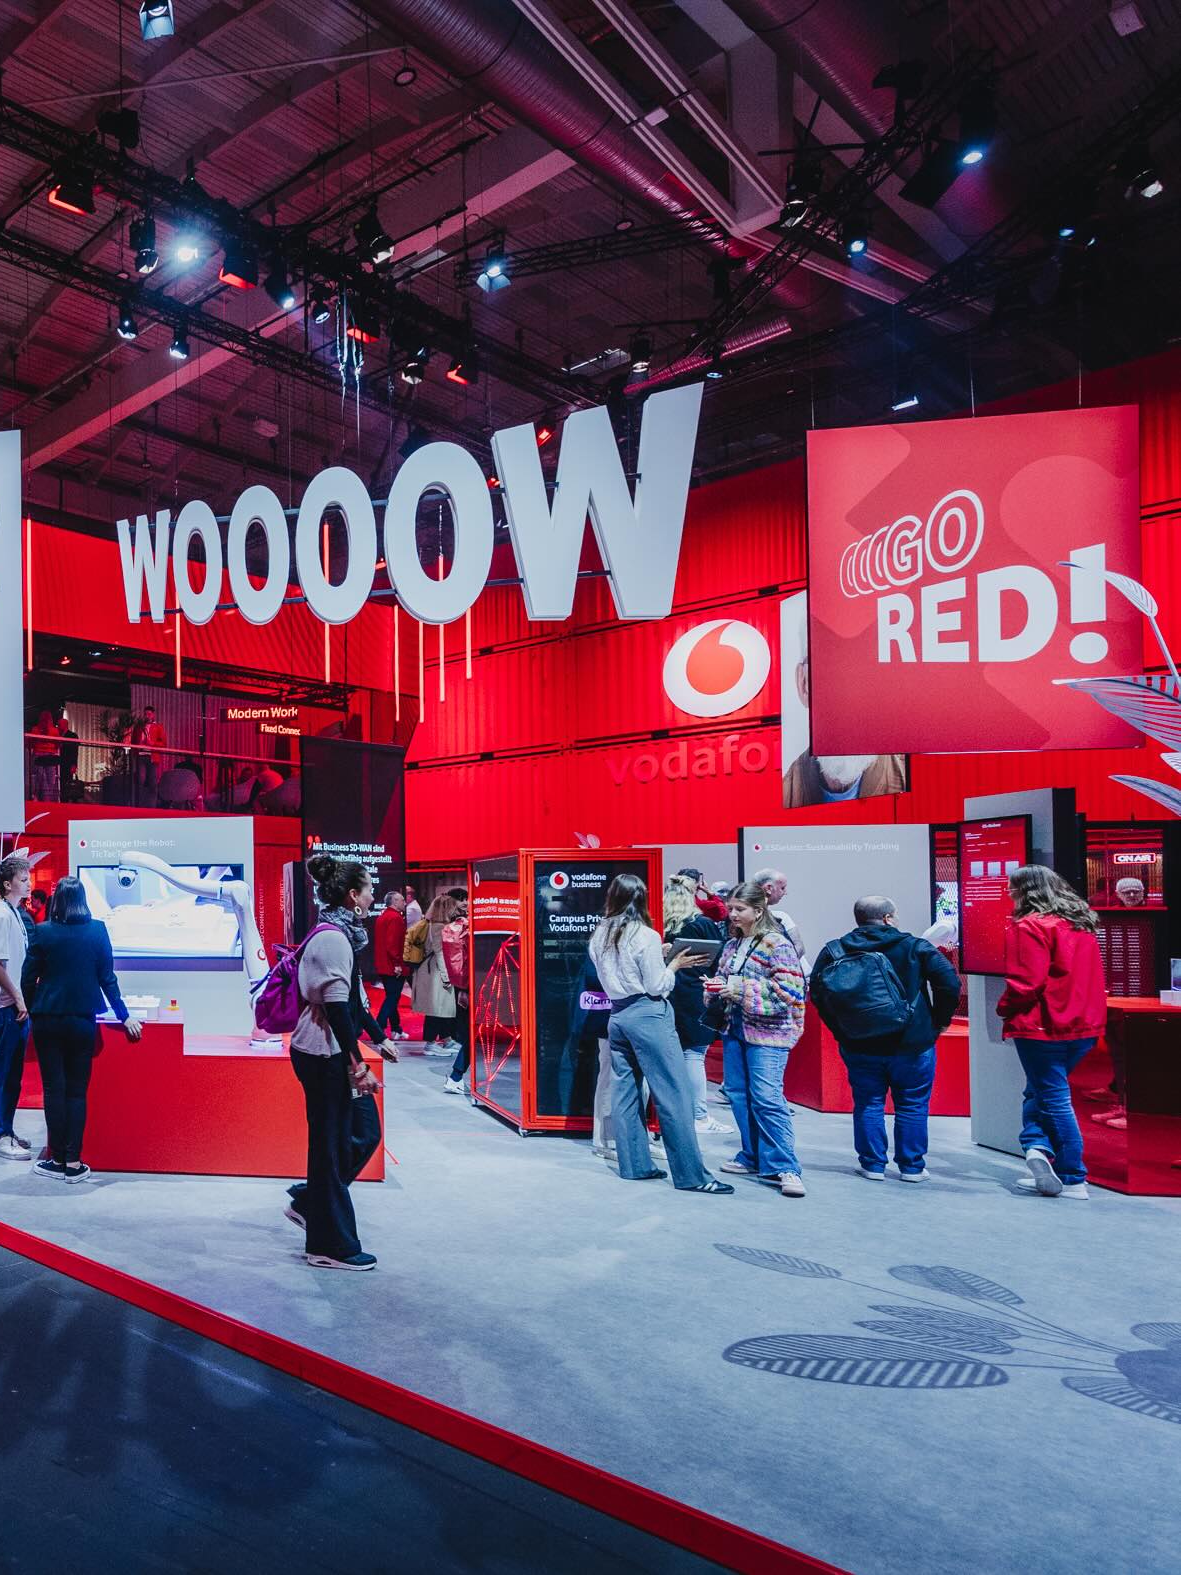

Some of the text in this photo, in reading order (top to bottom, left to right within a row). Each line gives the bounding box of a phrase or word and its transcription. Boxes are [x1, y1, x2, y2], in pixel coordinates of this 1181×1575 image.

[116, 381, 705, 626] WOOOOW
[840, 489, 985, 598] GO
[877, 543, 1109, 664] RED!
[227, 707, 270, 719] Modern
[260, 723, 301, 736] Fixed Connec
[605, 734, 781, 786] vodafo
[91, 839, 132, 848] Challenge
[133, 839, 148, 848] the
[312, 842, 385, 853] Mit Business SD-WAN sind
[863, 842, 900, 851] Tracking
[91, 850, 121, 859] TicTacT
[1133, 854, 1152, 862] AIR
[362, 855, 393, 864] aufgestellt
[570, 873, 607, 881] vodafone
[549, 914, 603, 924] Campus Priv
[549, 923, 588, 932] Vodafone
[584, 996, 610, 1005] Klarn
